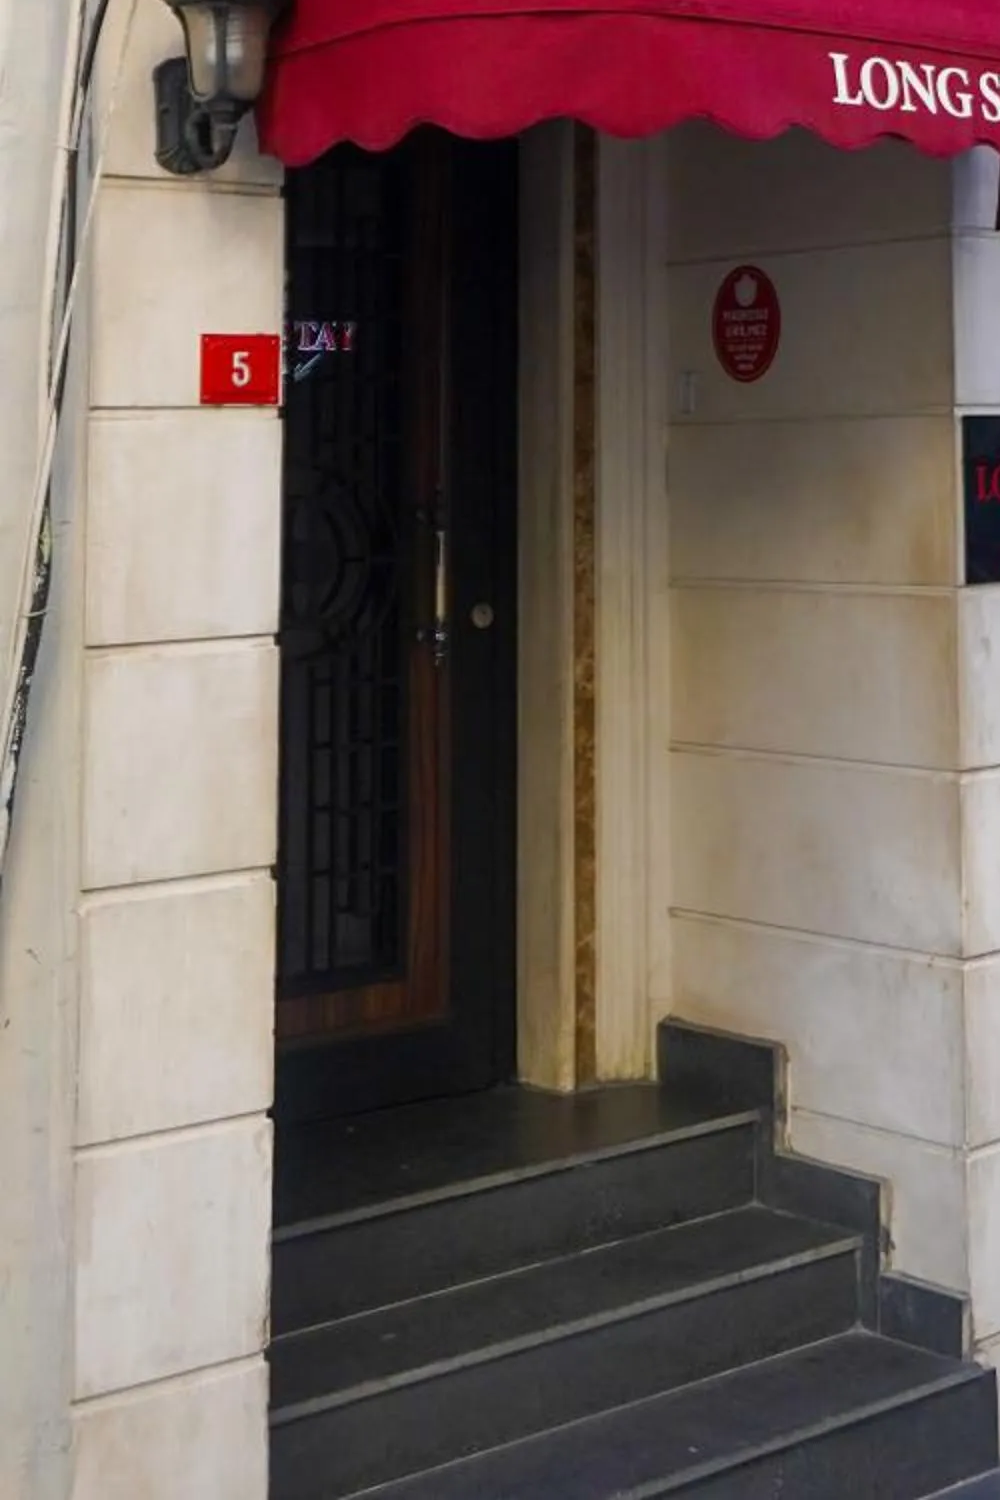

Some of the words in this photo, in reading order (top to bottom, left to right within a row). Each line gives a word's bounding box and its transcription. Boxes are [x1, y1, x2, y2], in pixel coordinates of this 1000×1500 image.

[828, 52, 973, 118] LONG
[284, 321, 356, 351] TAY
[232, 351, 251, 387] 5
